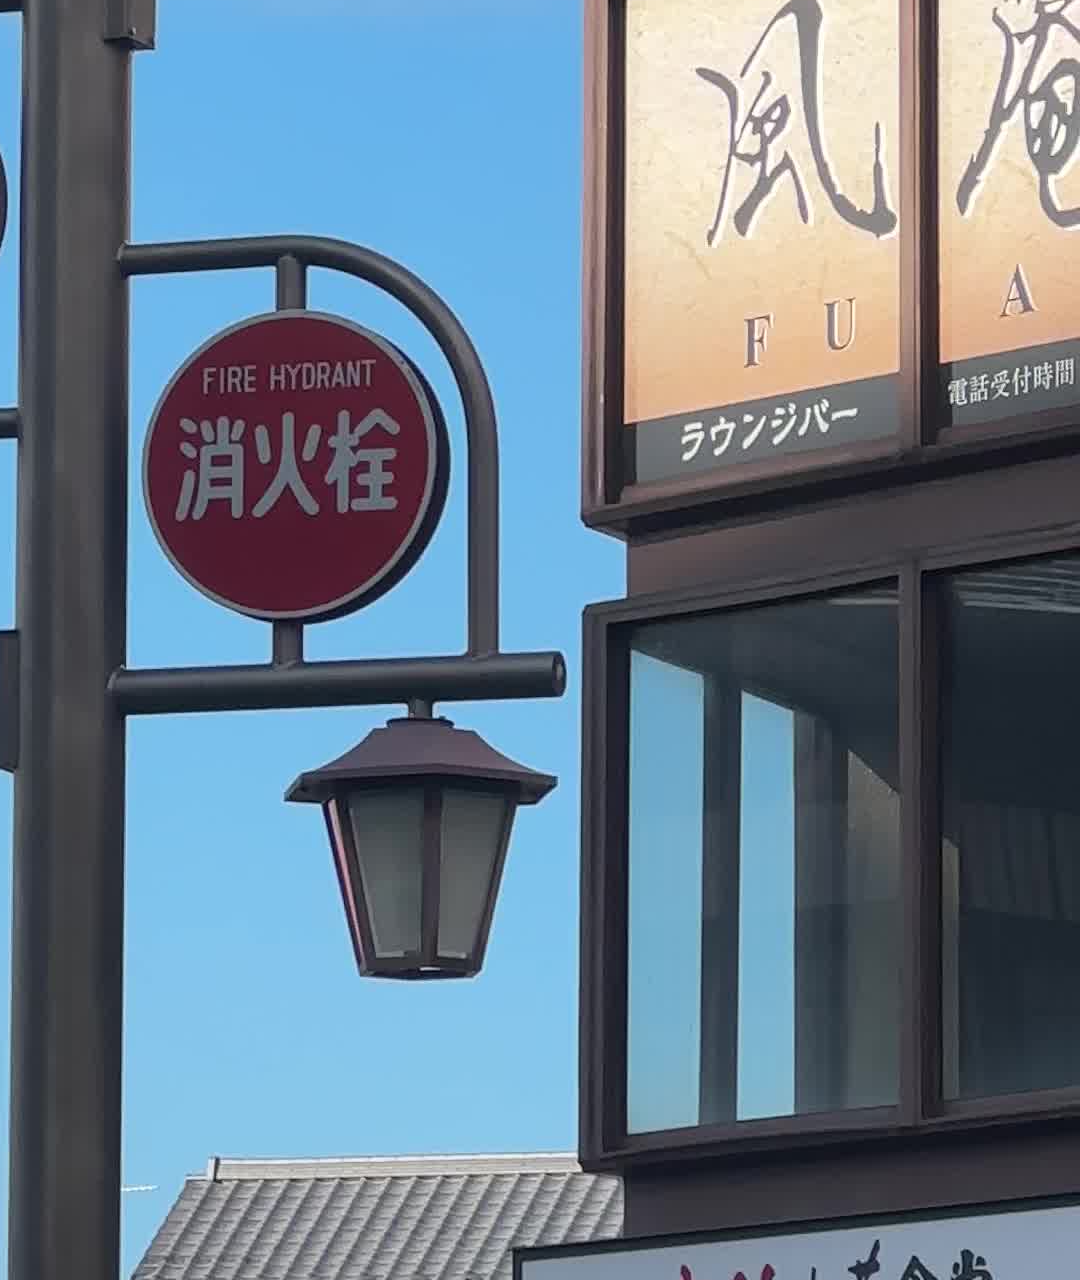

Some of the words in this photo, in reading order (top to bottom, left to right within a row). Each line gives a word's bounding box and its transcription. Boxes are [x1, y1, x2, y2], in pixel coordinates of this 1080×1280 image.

[202, 364, 257, 395] FIRE
[270, 359, 376, 391] HYDRANT
[947, 358, 1075, 406] 電話受付時間
[681, 398, 859, 461] ラウンジバー
[175, 408, 401, 521] 消火栓
